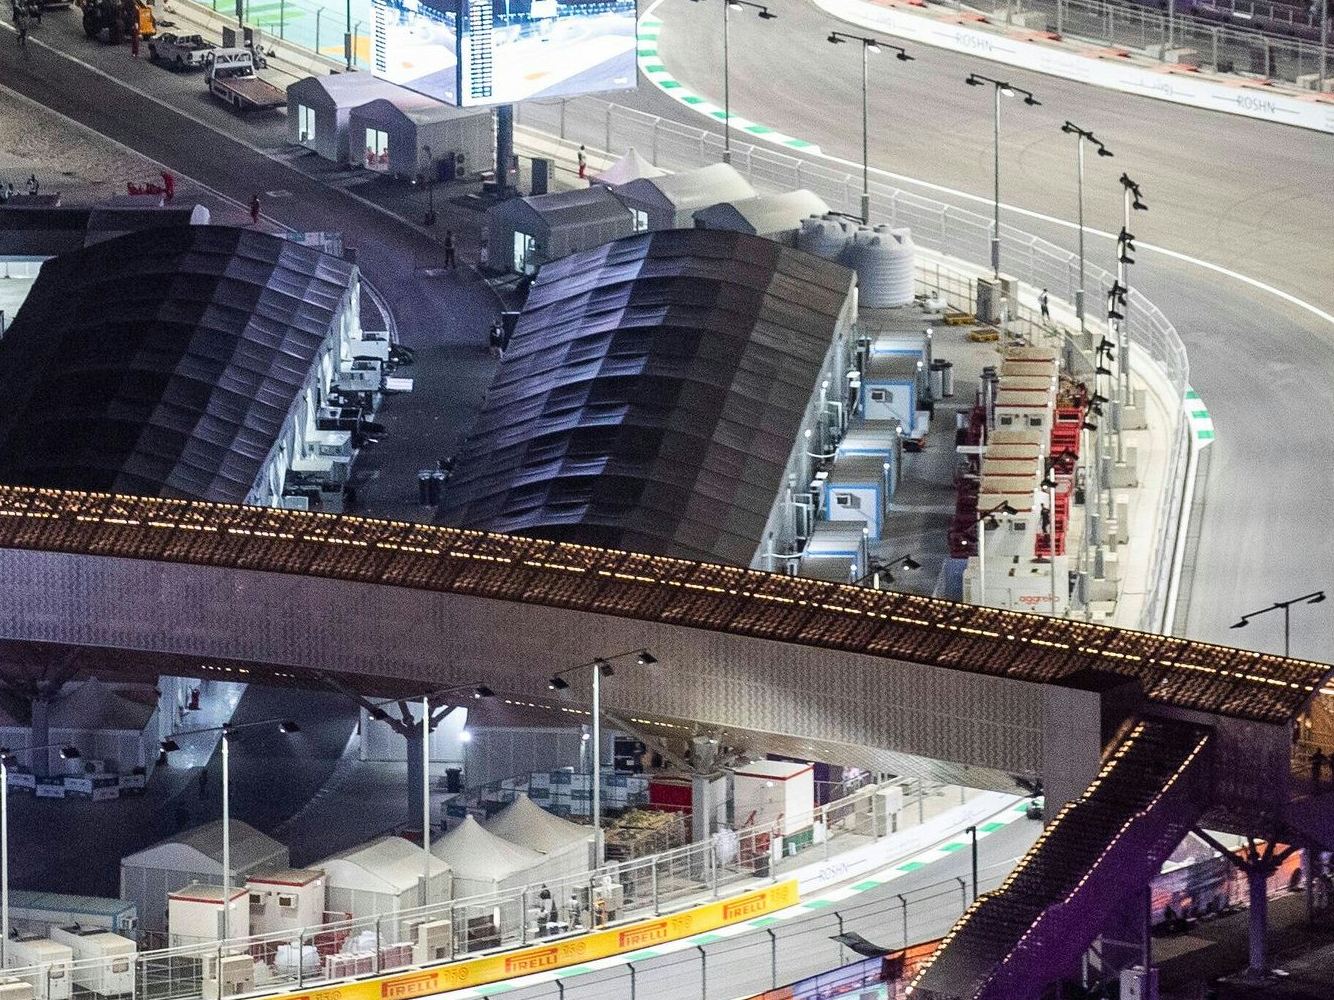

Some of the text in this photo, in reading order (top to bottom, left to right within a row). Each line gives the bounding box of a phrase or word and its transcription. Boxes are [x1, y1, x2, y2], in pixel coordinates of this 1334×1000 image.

[956, 32, 993, 51] ROSHN
[1236, 94, 1276, 114] ROSHN
[723, 893, 766, 920] PIRELLI
[619, 922, 667, 948] PIRELLI
[505, 948, 559, 972] PIRELLI
[381, 973, 439, 998] PIRELLI
